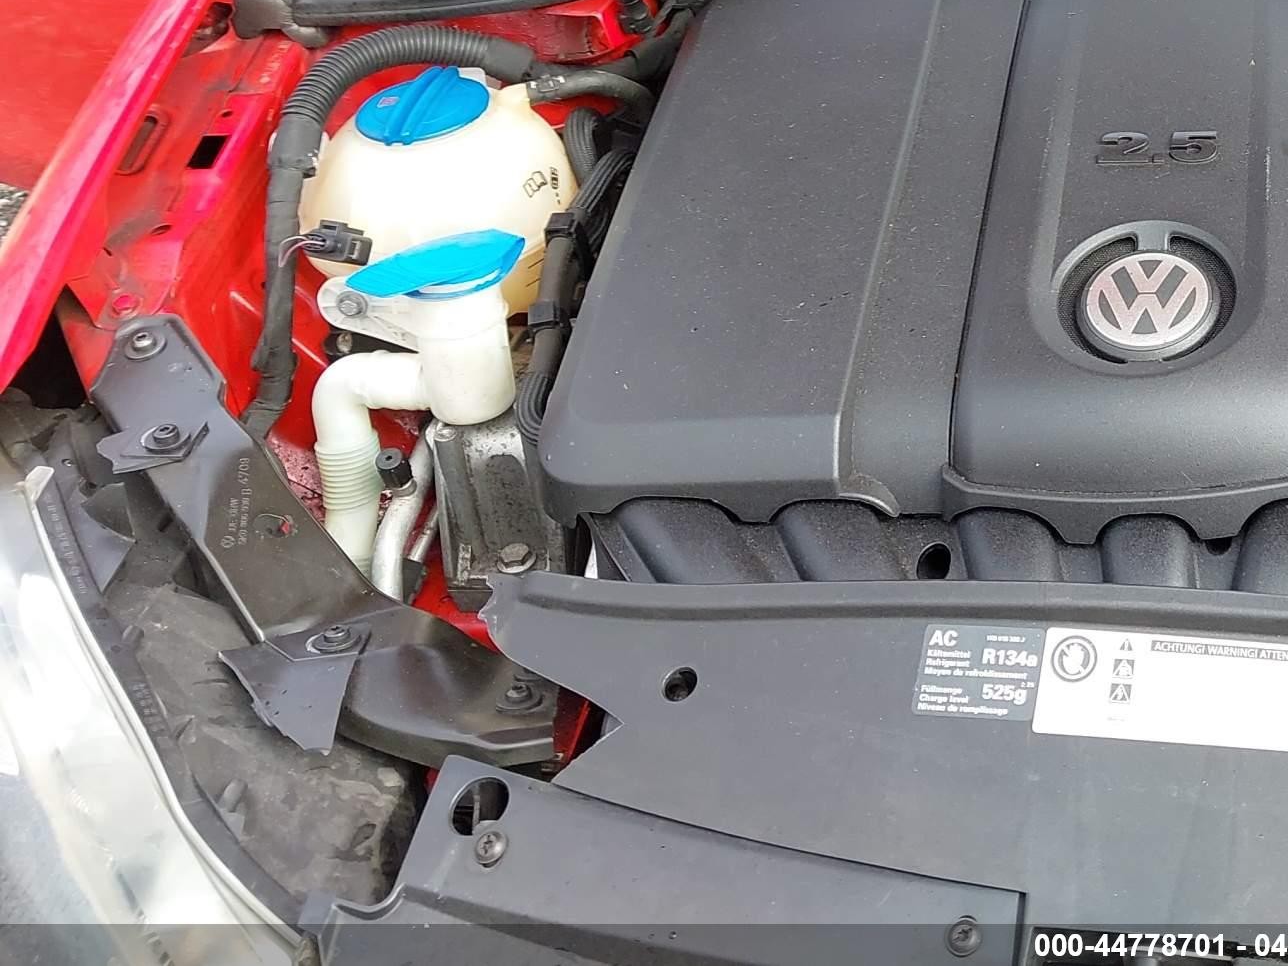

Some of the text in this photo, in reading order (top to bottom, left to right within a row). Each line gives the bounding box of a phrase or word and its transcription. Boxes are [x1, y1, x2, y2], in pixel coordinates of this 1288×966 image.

[1096, 130, 1218, 165] 2.5
[929, 630, 958, 647] AC
[982, 648, 1038, 667] R134a
[1155, 641, 1208, 654] ACHTUNG!
[1208, 645, 1258, 658] WARNING!
[982, 684, 1027, 705] 525g
